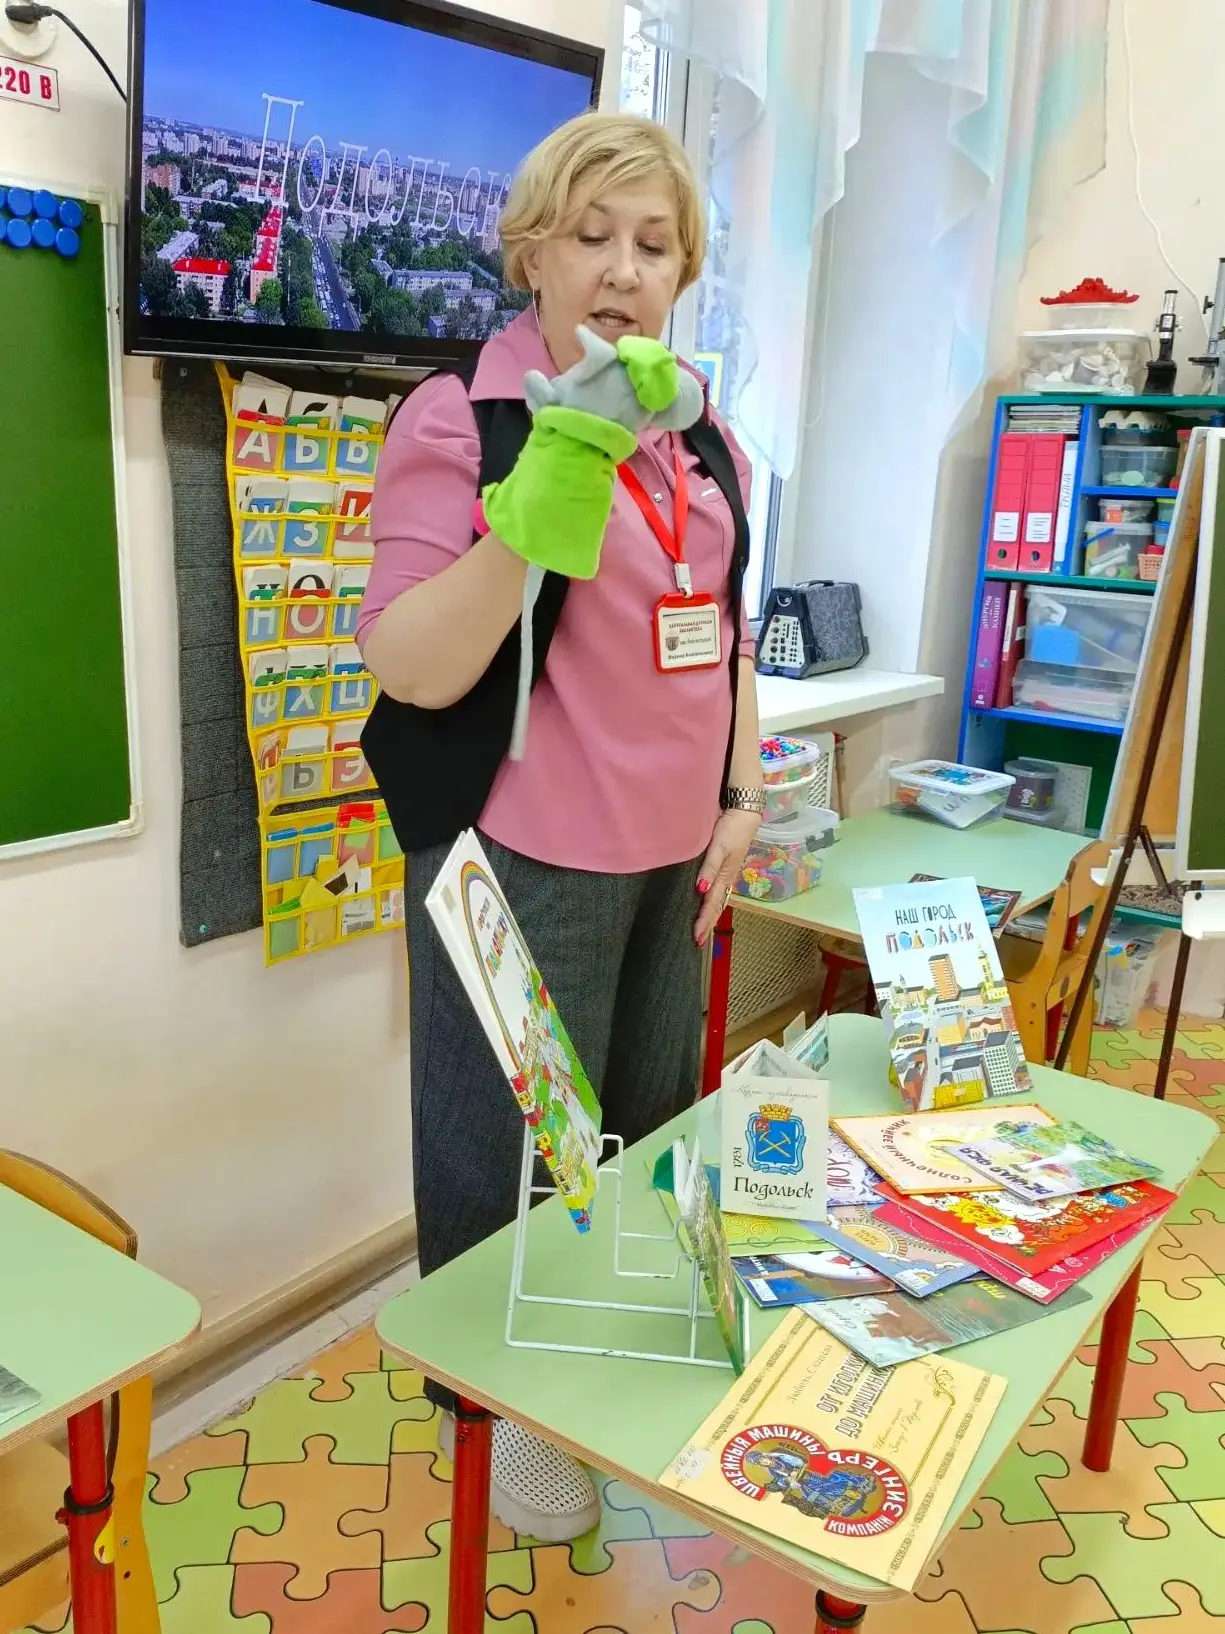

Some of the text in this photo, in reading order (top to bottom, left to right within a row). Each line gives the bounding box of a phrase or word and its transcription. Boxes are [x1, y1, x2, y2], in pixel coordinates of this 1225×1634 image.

[0, 65, 52, 100] 20 В
[895, 903, 957, 926] НАШ ГОРОД
[886, 921, 975, 954] ПОДОЛЬСК
[958, 1147, 1054, 1195] РЕЧНАЯ ФЕЯ
[734, 1176, 814, 1200] Подольск
[816, 1395, 844, 1414] ОТ
[748, 1425, 827, 1456] МАШИНЫ
[834, 1416, 864, 1439] ДО
